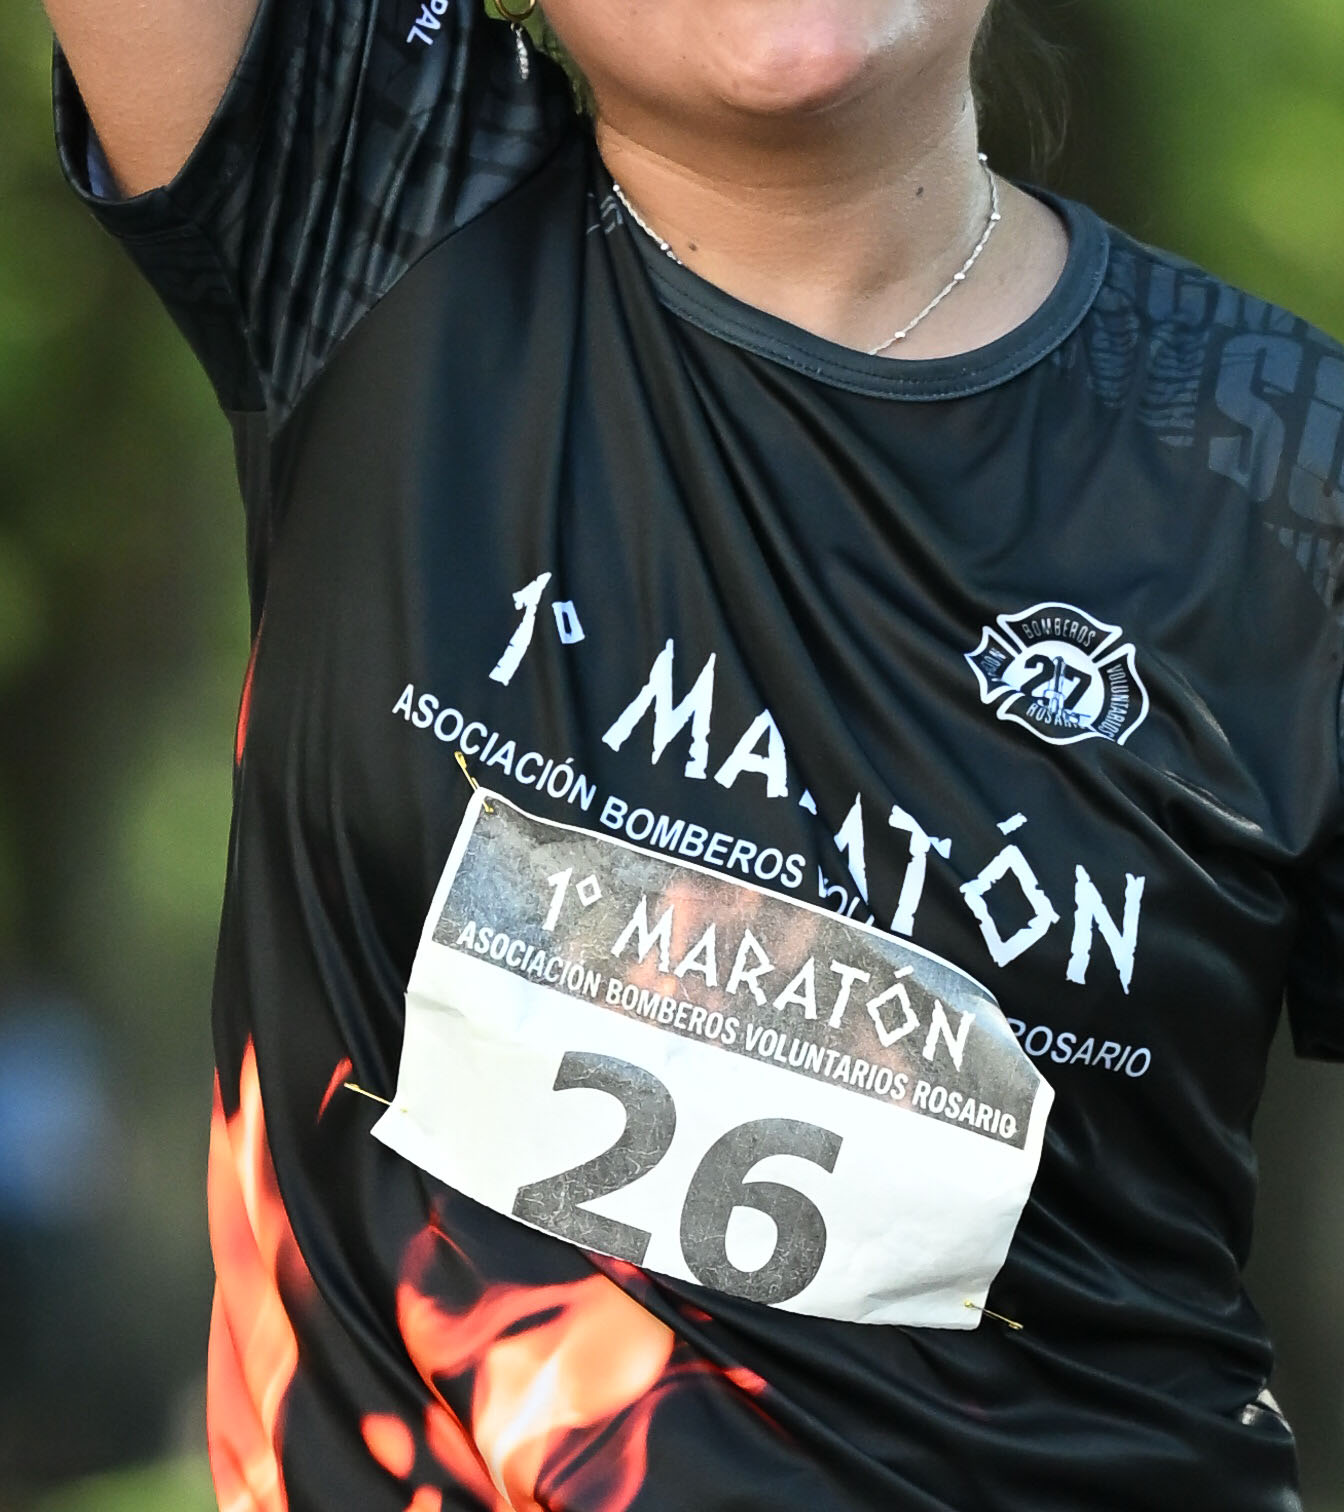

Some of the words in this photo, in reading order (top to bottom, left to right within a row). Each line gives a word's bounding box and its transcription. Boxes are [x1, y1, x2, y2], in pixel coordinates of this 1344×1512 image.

[1021, 618, 1097, 648] BOMBEROS
[1097, 662, 1131, 742] VOLUNTARIOS
[392, 683, 597, 812] ASOCIACIÓN
[599, 795, 806, 889] BOMBEROS
[456, 920, 605, 1000] ASOCIACIÓN
[604, 976, 738, 1046] BOMBEROS
[744, 1022, 908, 1102] VOLUNTARIOS
[911, 1079, 1018, 1140] ROSARIO
[611, 894, 977, 1072] MARATÓN
[511, 1050, 845, 1306] 26
